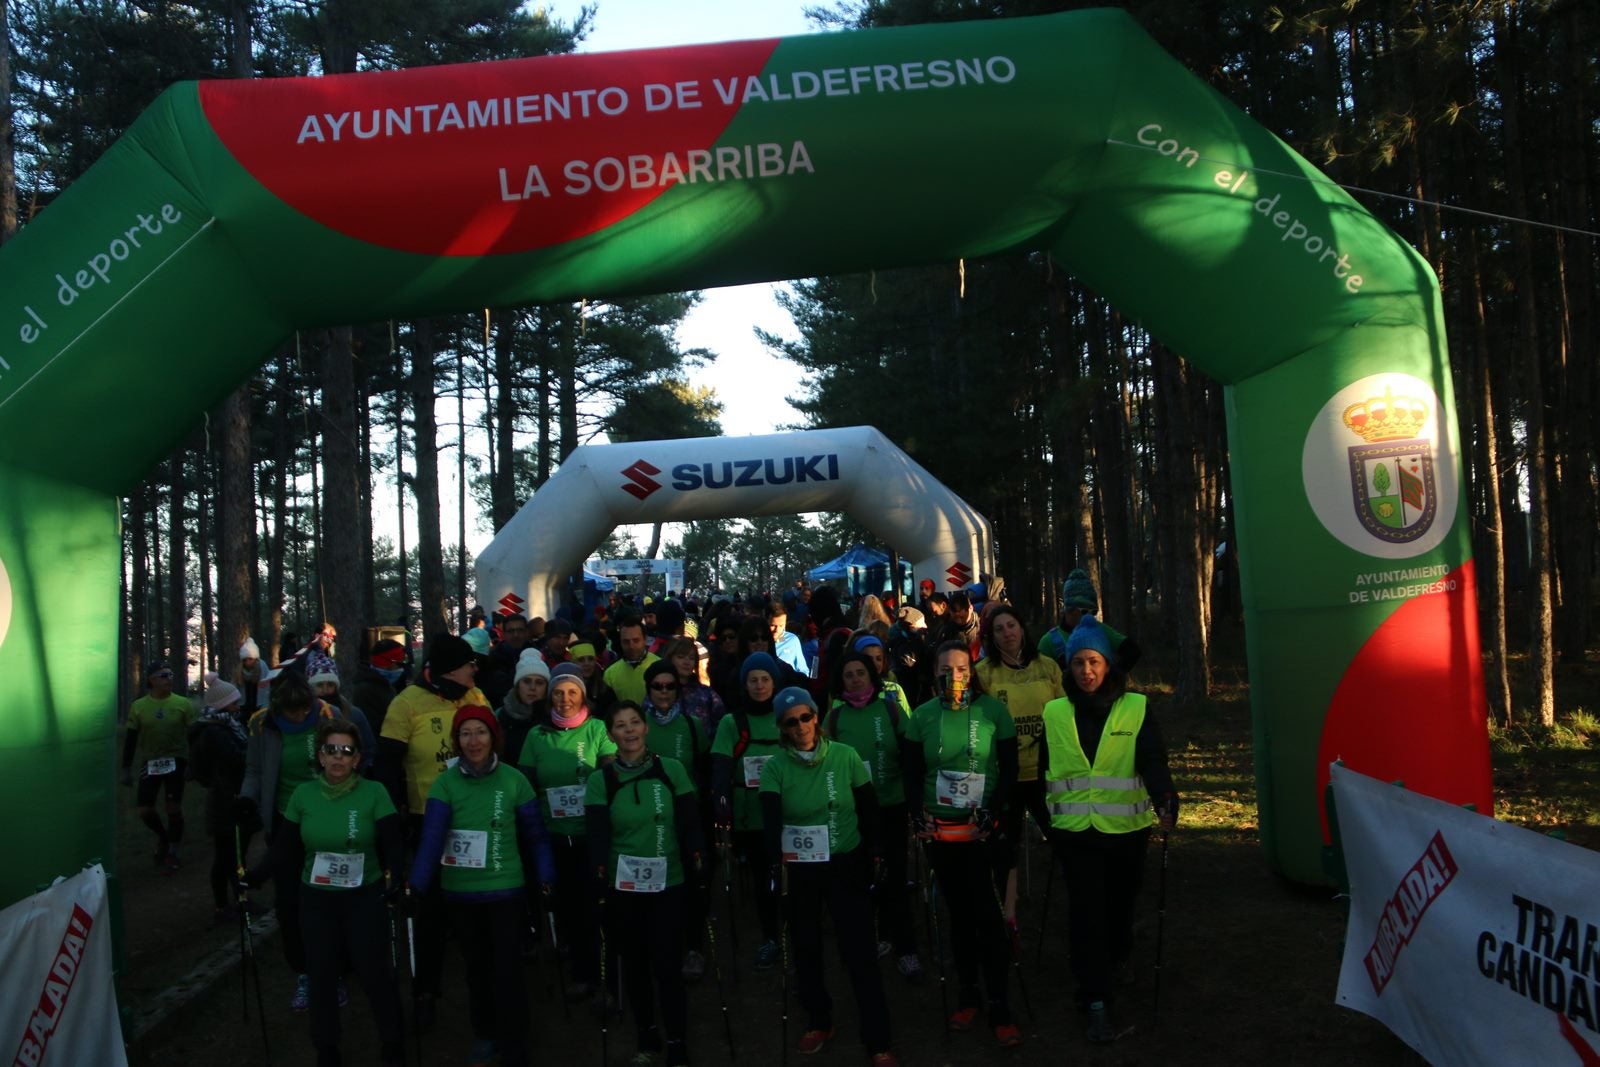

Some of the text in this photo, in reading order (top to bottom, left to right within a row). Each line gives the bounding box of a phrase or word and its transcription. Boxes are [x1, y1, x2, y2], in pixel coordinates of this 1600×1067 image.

[297, 56, 1016, 144] AYUNTAMIENTO DE VALDEFRESNO
[498, 140, 815, 202] LA SOBARRIBA
[1136, 124, 1364, 293] Con el deporte
[20, 204, 182, 343] el deporte
[671, 454, 839, 491] SUZUKI
[1355, 564, 1450, 586] AYUNTAMIENTO
[1349, 579, 1457, 603] DE VALDEFRESNO
[948, 782, 969, 795] 53
[560, 795, 578, 806] 56
[453, 840, 471, 854] 67
[792, 836, 814, 849] 66
[328, 862, 349, 875] 58
[633, 868, 652, 880] 13
[1477, 931, 1600, 1034] CANDA
